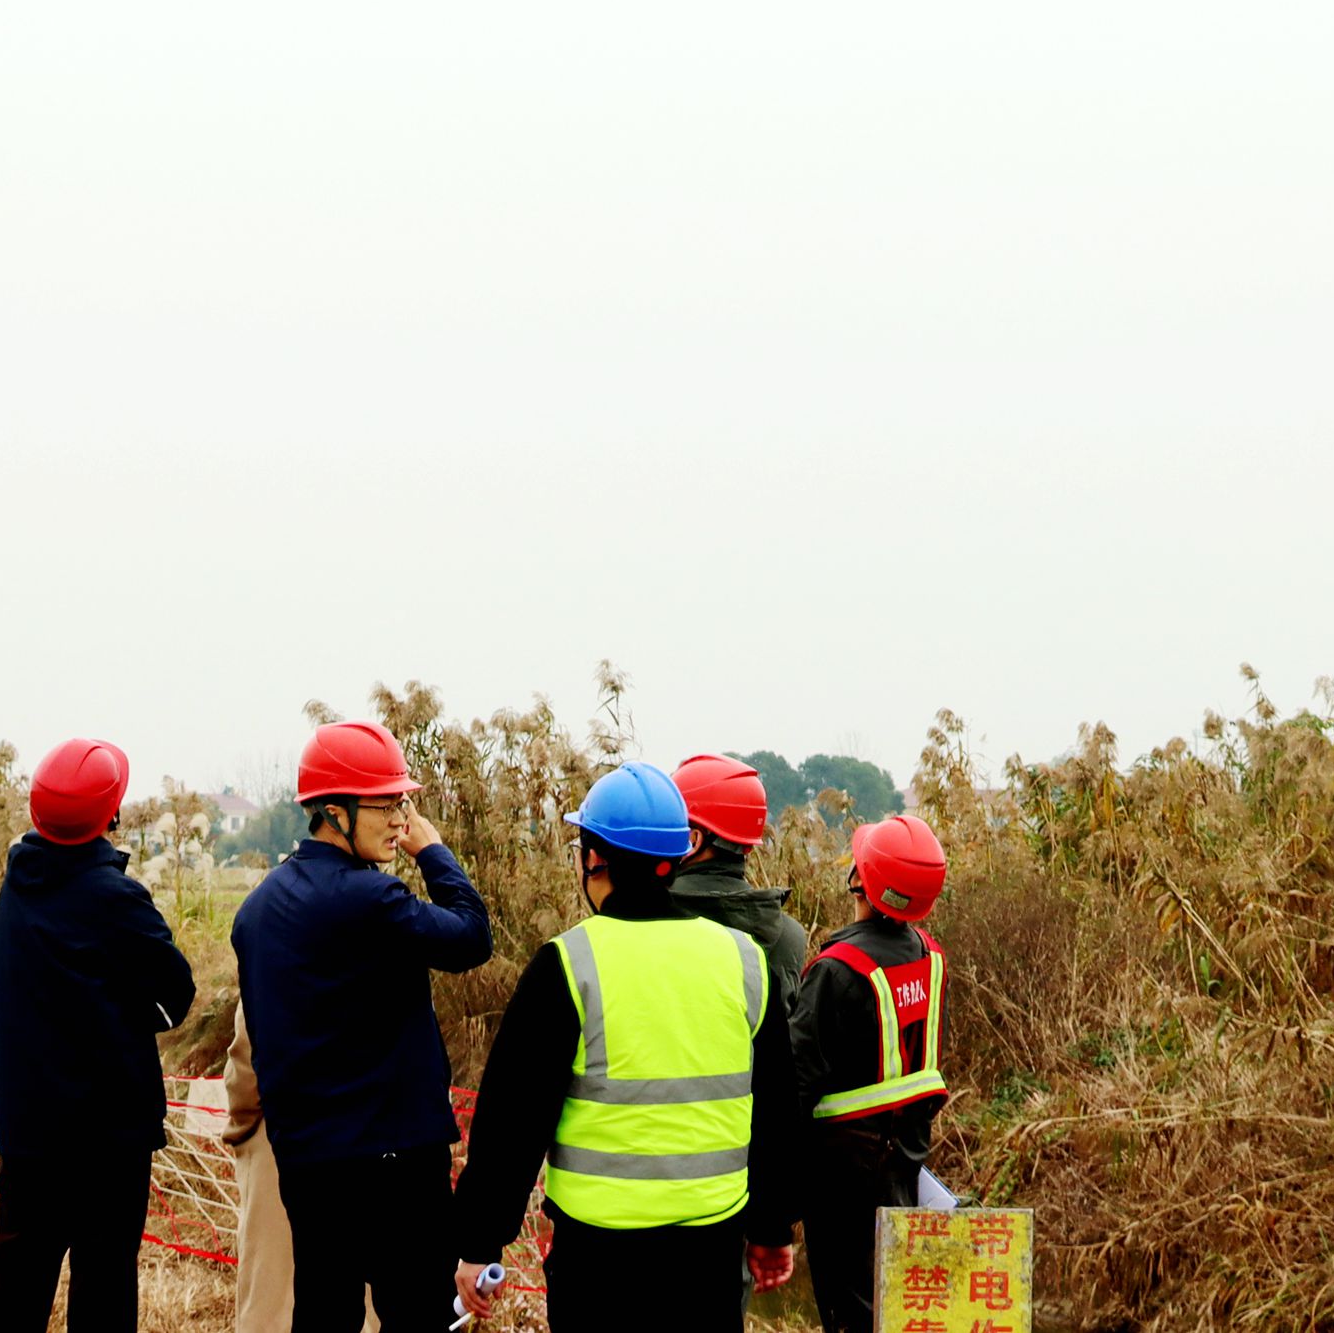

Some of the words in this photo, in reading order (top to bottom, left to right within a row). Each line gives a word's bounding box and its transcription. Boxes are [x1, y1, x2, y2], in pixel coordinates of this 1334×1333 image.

[896, 978, 927, 1008] 工作负责人
